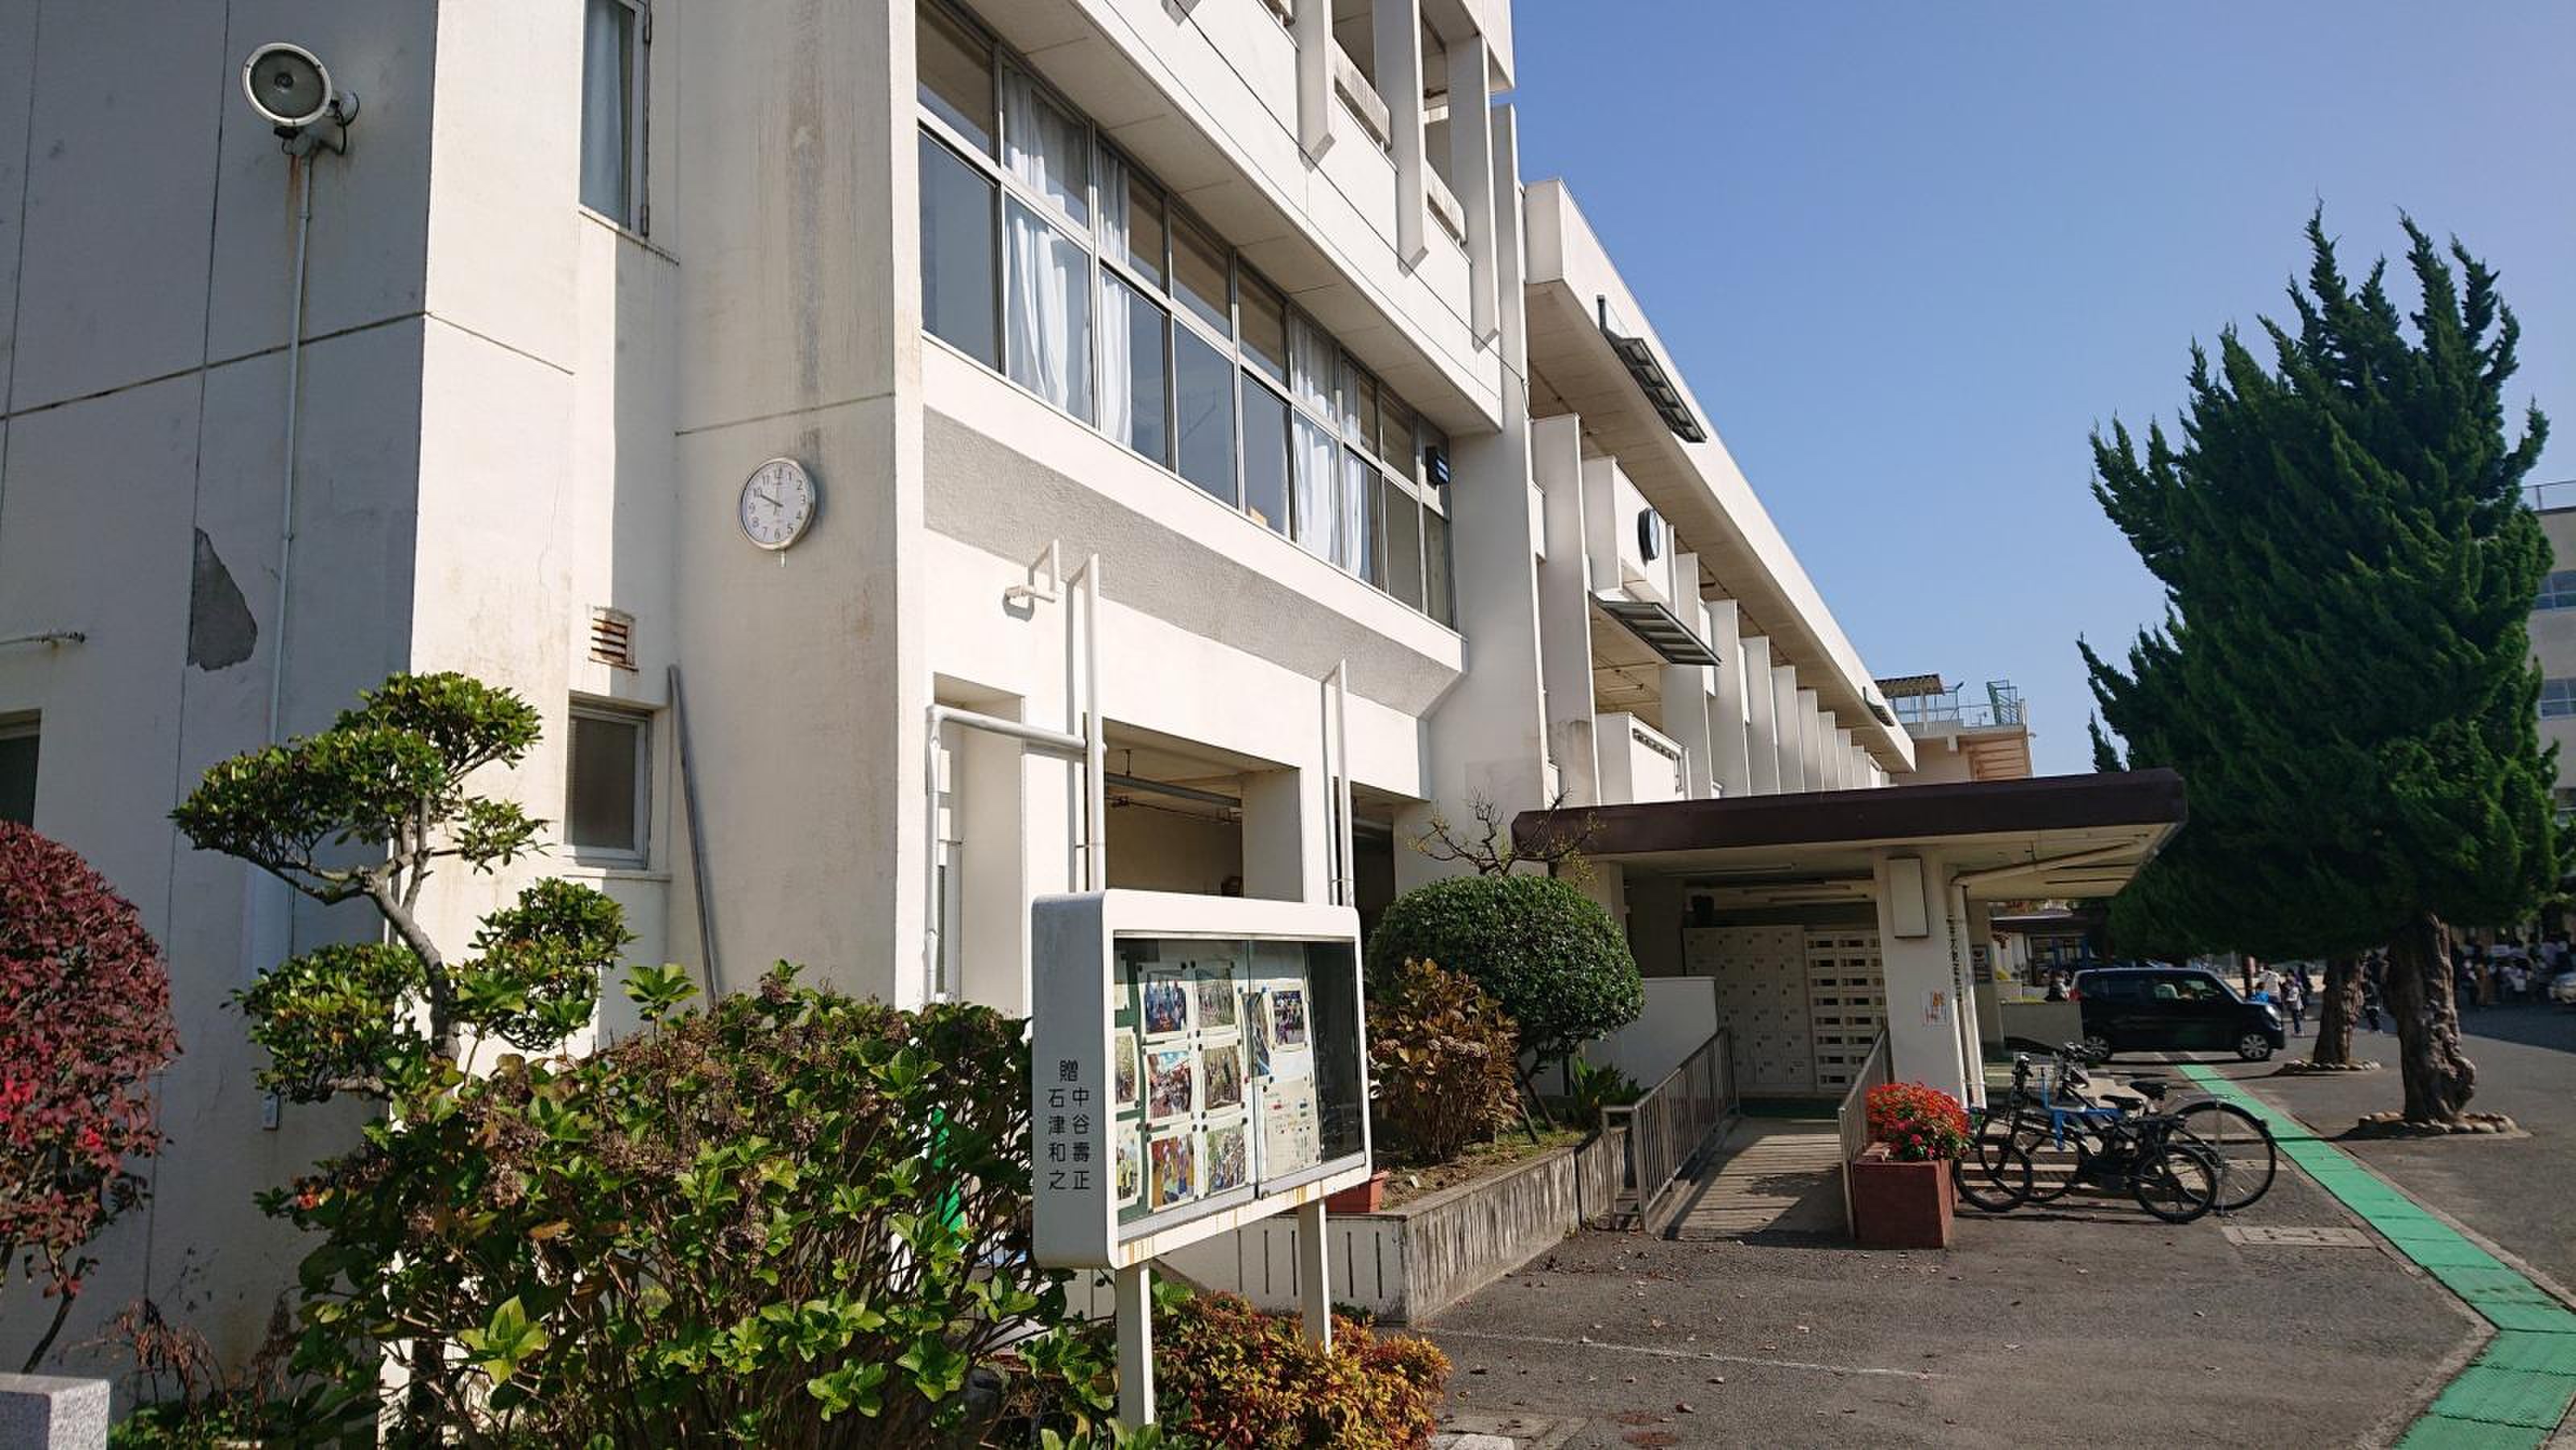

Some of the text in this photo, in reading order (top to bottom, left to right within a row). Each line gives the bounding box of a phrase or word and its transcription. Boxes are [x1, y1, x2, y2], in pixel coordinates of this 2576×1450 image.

[762, 475, 770, 487] 11
[789, 471, 793, 481] 1
[797, 480, 804, 490] 2
[800, 494, 806, 503] 3
[748, 502, 756, 514] 9
[796, 510, 802, 520] 4
[752, 516, 760, 528] 8
[762, 526, 768, 537] 7
[774, 529, 781, 540] 6
[787, 524, 794, 534] 5
[1059, 1059, 1079, 1082] 贈
[1048, 1089, 1066, 1190] 石津和之
[1072, 1087, 1091, 1190] 中谷壽正
